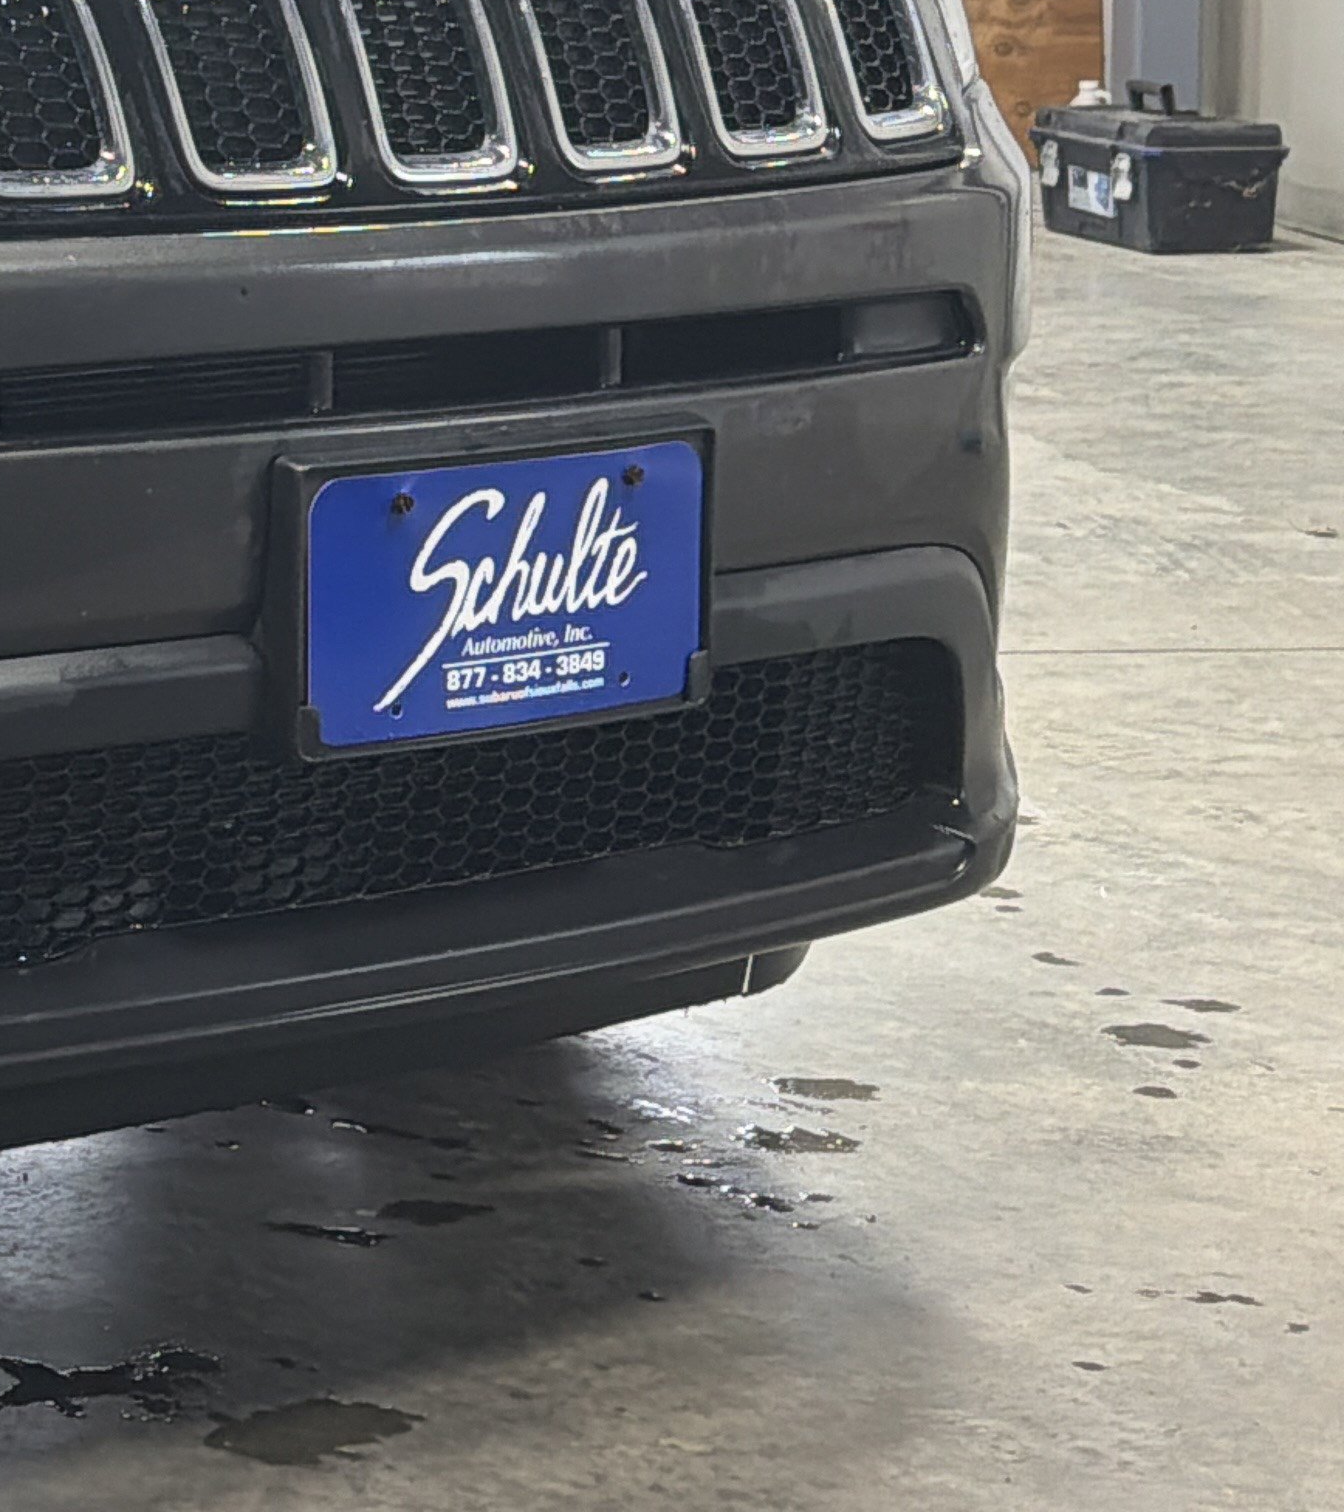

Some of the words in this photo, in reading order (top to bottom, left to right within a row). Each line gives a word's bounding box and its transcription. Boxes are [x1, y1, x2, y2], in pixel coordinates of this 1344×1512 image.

[373, 477, 647, 713] Schulte
[461, 627, 560, 657] Automotive,
[564, 623, 594, 643] Inc.
